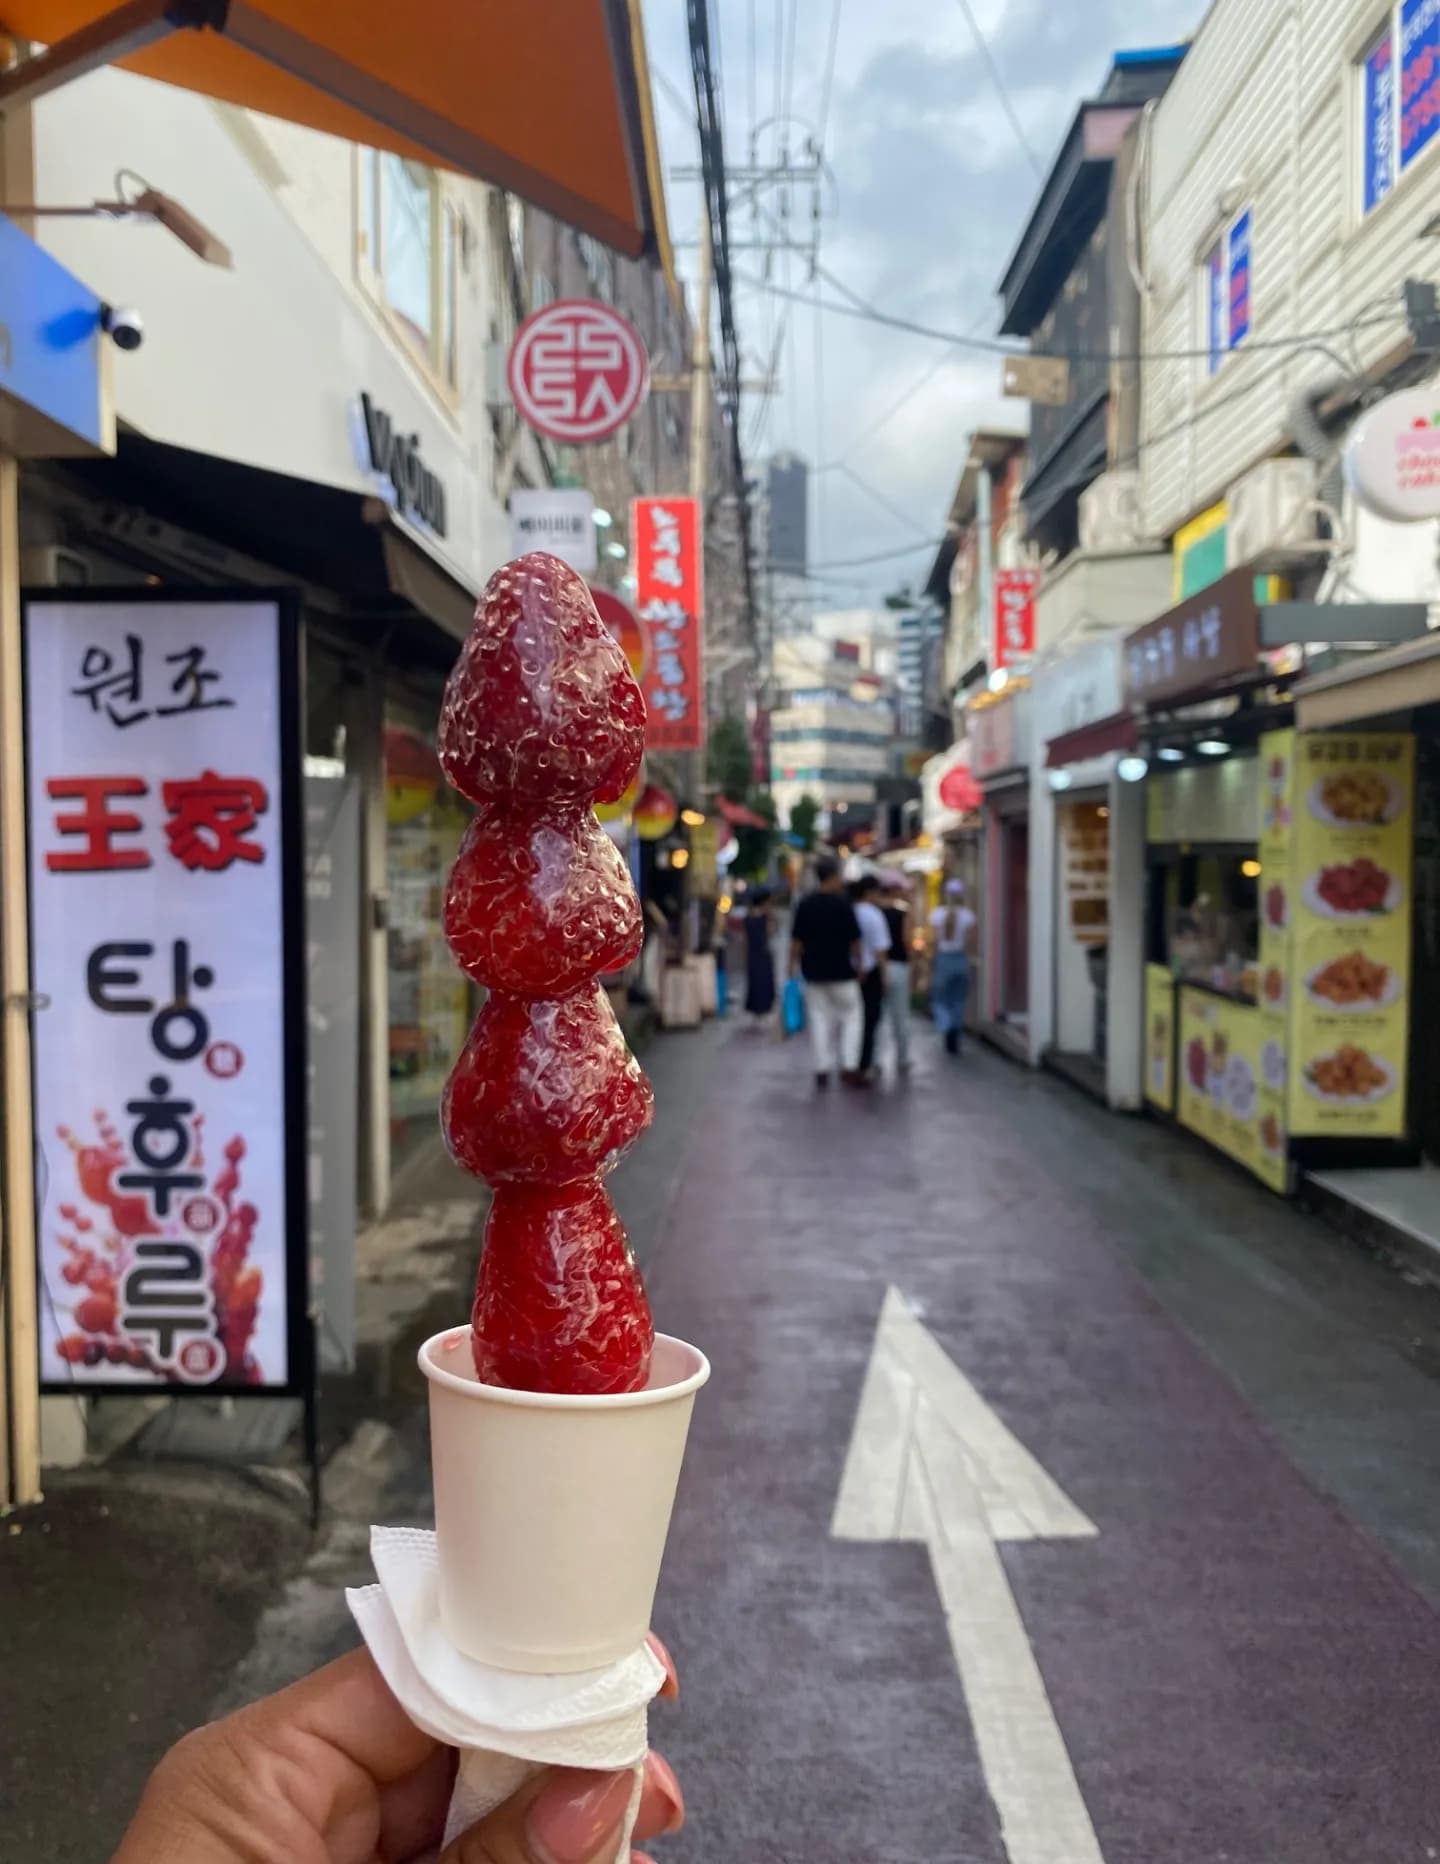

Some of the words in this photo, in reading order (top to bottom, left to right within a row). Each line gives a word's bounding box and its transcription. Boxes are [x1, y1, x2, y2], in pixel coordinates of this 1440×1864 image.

[71, 632, 237, 729] 원조
[44, 769, 269, 872] 王家
[86, 937, 215, 1361] 탕후루
